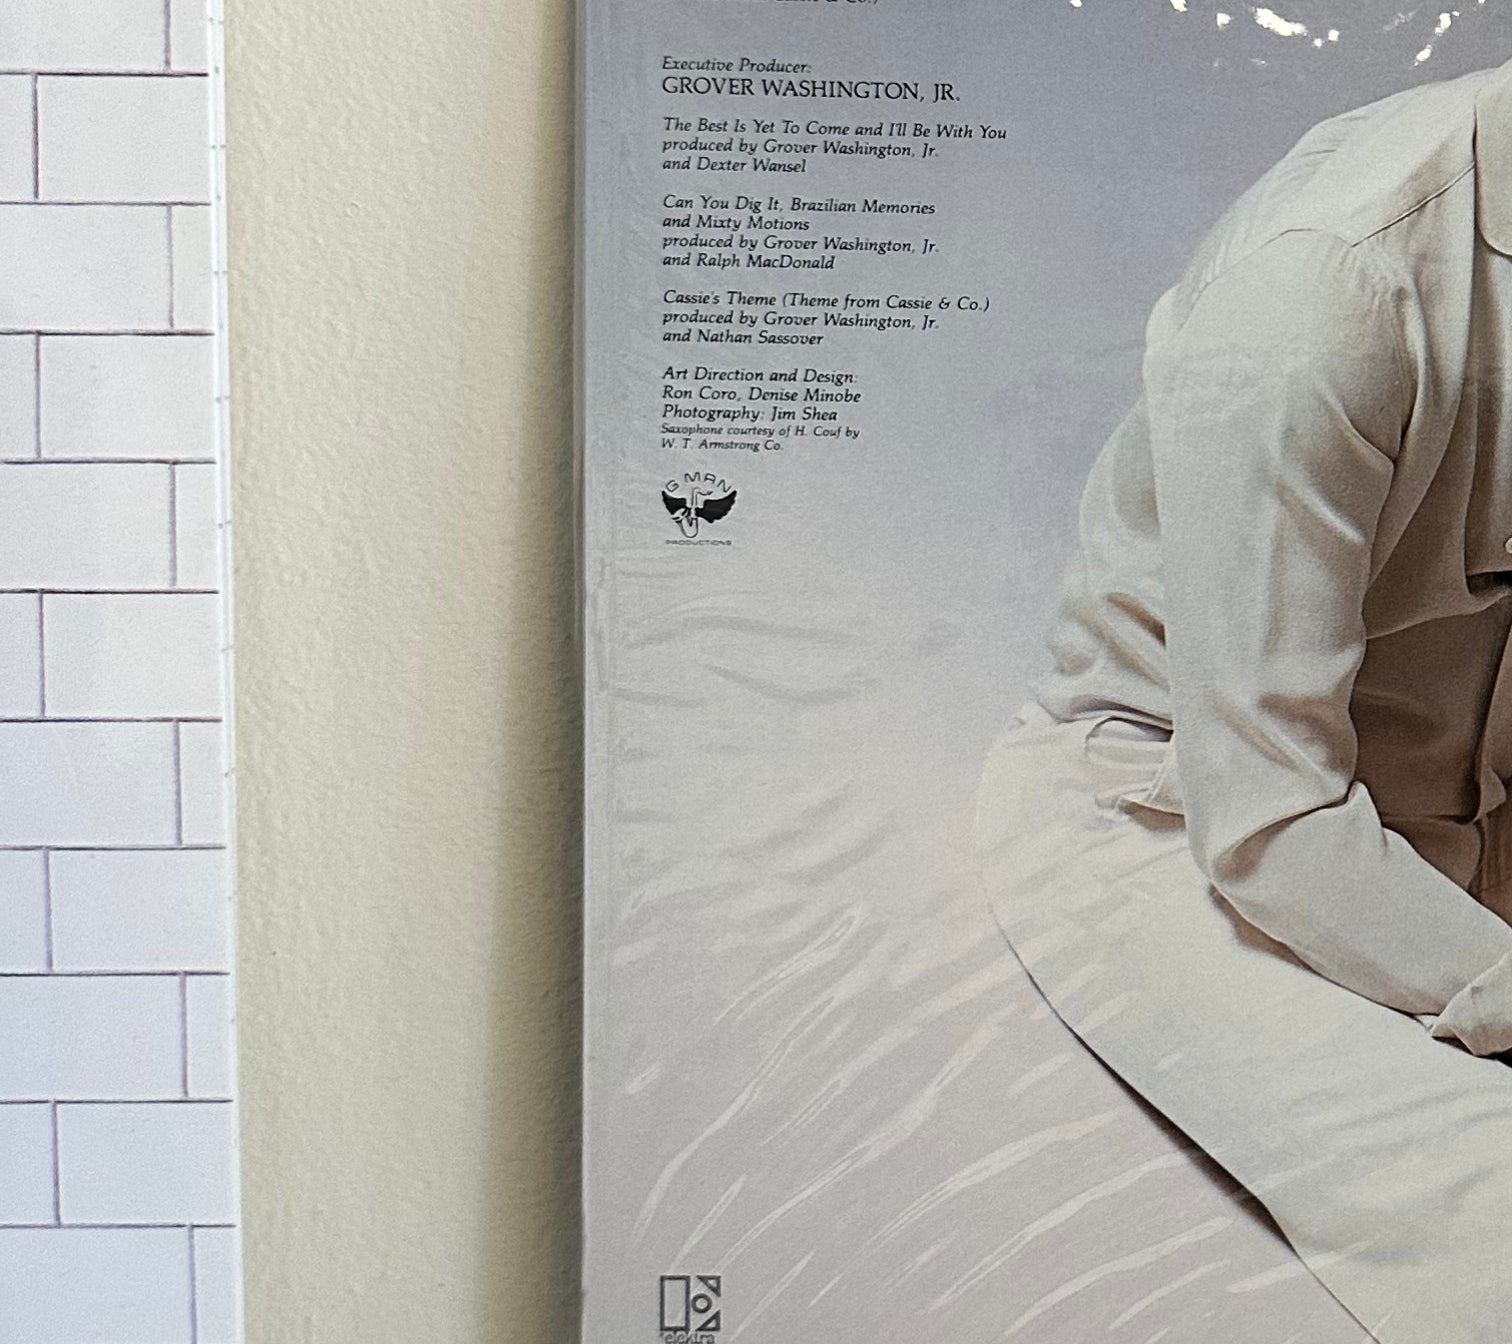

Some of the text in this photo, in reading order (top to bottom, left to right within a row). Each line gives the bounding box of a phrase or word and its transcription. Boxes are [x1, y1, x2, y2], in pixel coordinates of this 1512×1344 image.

[661, 55, 734, 71] Executive
[661, 75, 960, 103] GROVER WASHINGTON, JR.
[663, 116, 692, 131] The
[697, 117, 728, 132] Best
[733, 118, 746, 133] Is
[752, 118, 775, 133] Yet
[781, 119, 800, 134] To
[805, 119, 850, 135] Come
[854, 121, 883, 136] and
[912, 122, 931, 137] Be
[936, 123, 973, 138] With
[978, 124, 1007, 139] You
[661, 136, 938, 159] produced by Grover Washington, Jr.
[661, 155, 806, 173] and Dexter Wansel
[662, 193, 693, 208] Can
[699, 194, 729, 209] You
[734, 195, 762, 214] Dig
[789, 196, 856, 212] Brazilian
[861, 198, 935, 214] Memories
[661, 213, 810, 232] and Mixty Motions
[662, 232, 938, 255] produced by Grover Washington, Jr.
[661, 252, 835, 270] and Ralph MacDonald
[662, 288, 990, 312] Cassie's Theme (Theme from Cassie & Co.)
[662, 309, 938, 331] produced by Grover Washington, Jr.
[661, 328, 824, 345] and Nathan Sassover
[661, 365, 688, 380] Art
[693, 365, 764, 381] Direction
[768, 367, 798, 382] and
[661, 384, 692, 399] Ron
[747, 385, 798, 401] Denise
[802, 387, 861, 403] Minobe
[770, 405, 796, 422] Jim
[801, 405, 837, 421] Shea
[726, 426, 775, 438] courtesy
[777, 424, 791, 438] of
[844, 425, 860, 440] by
[697, 438, 760, 453] Armstrong
